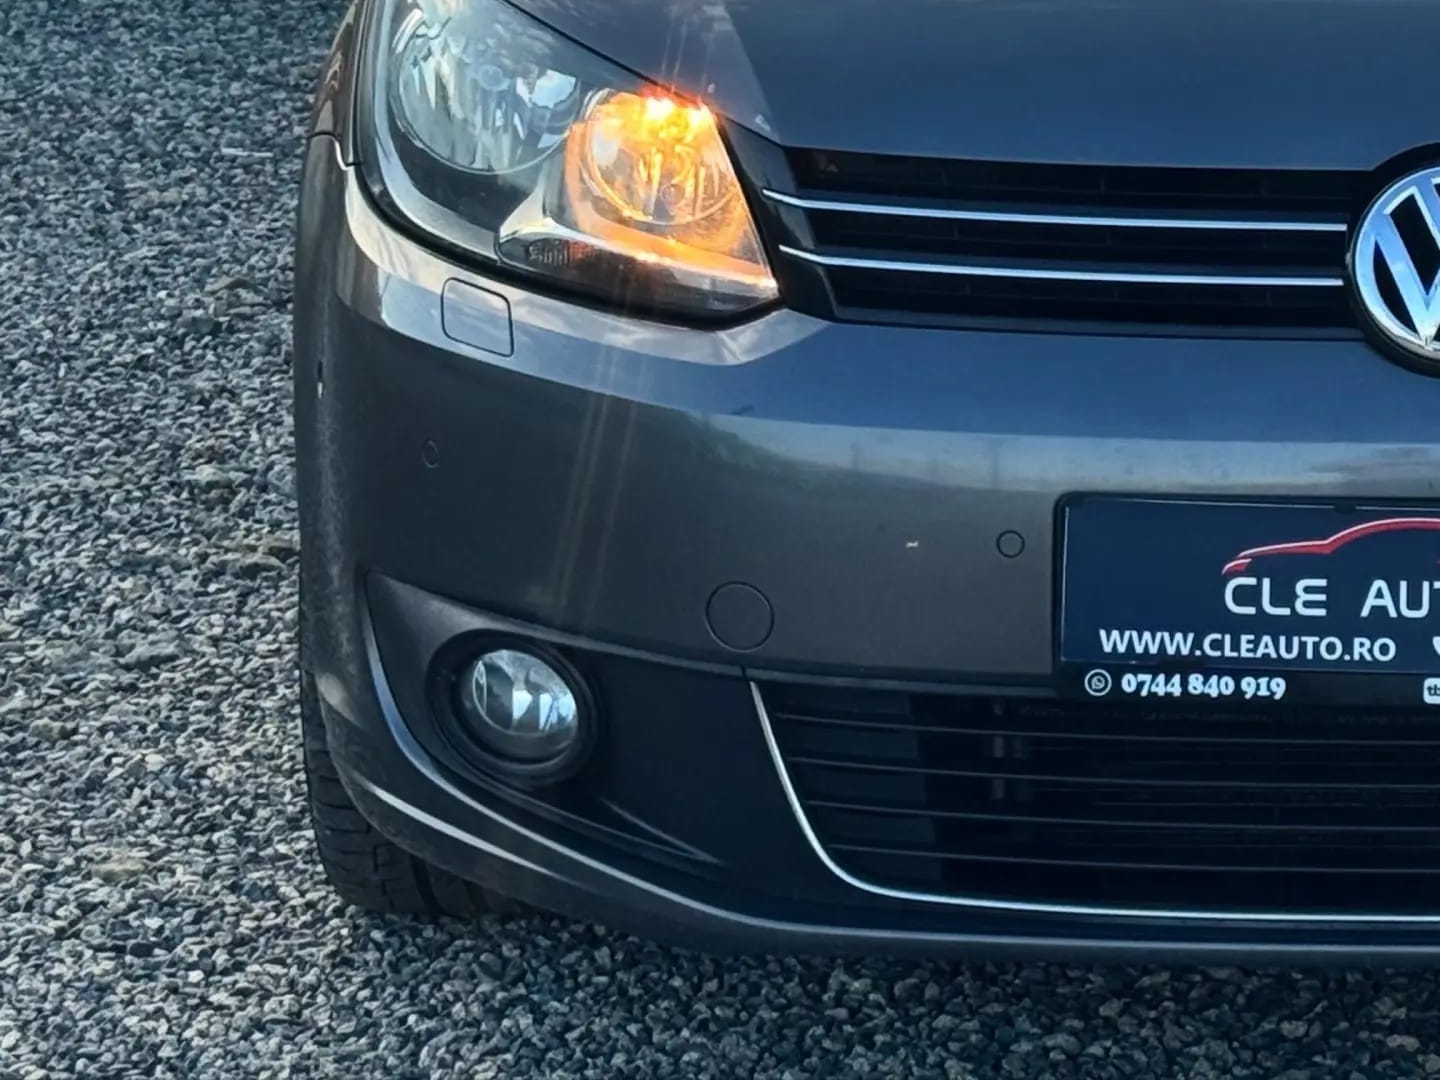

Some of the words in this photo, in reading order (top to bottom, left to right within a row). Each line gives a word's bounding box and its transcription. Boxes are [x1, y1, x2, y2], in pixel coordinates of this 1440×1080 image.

[1224, 577, 1328, 617] CLE
[1099, 629, 1397, 662] WWW.CLEAUTO.RO
[1121, 673, 1182, 697] 0744
[1187, 673, 1235, 697] 840
[1240, 676, 1286, 700] 919
